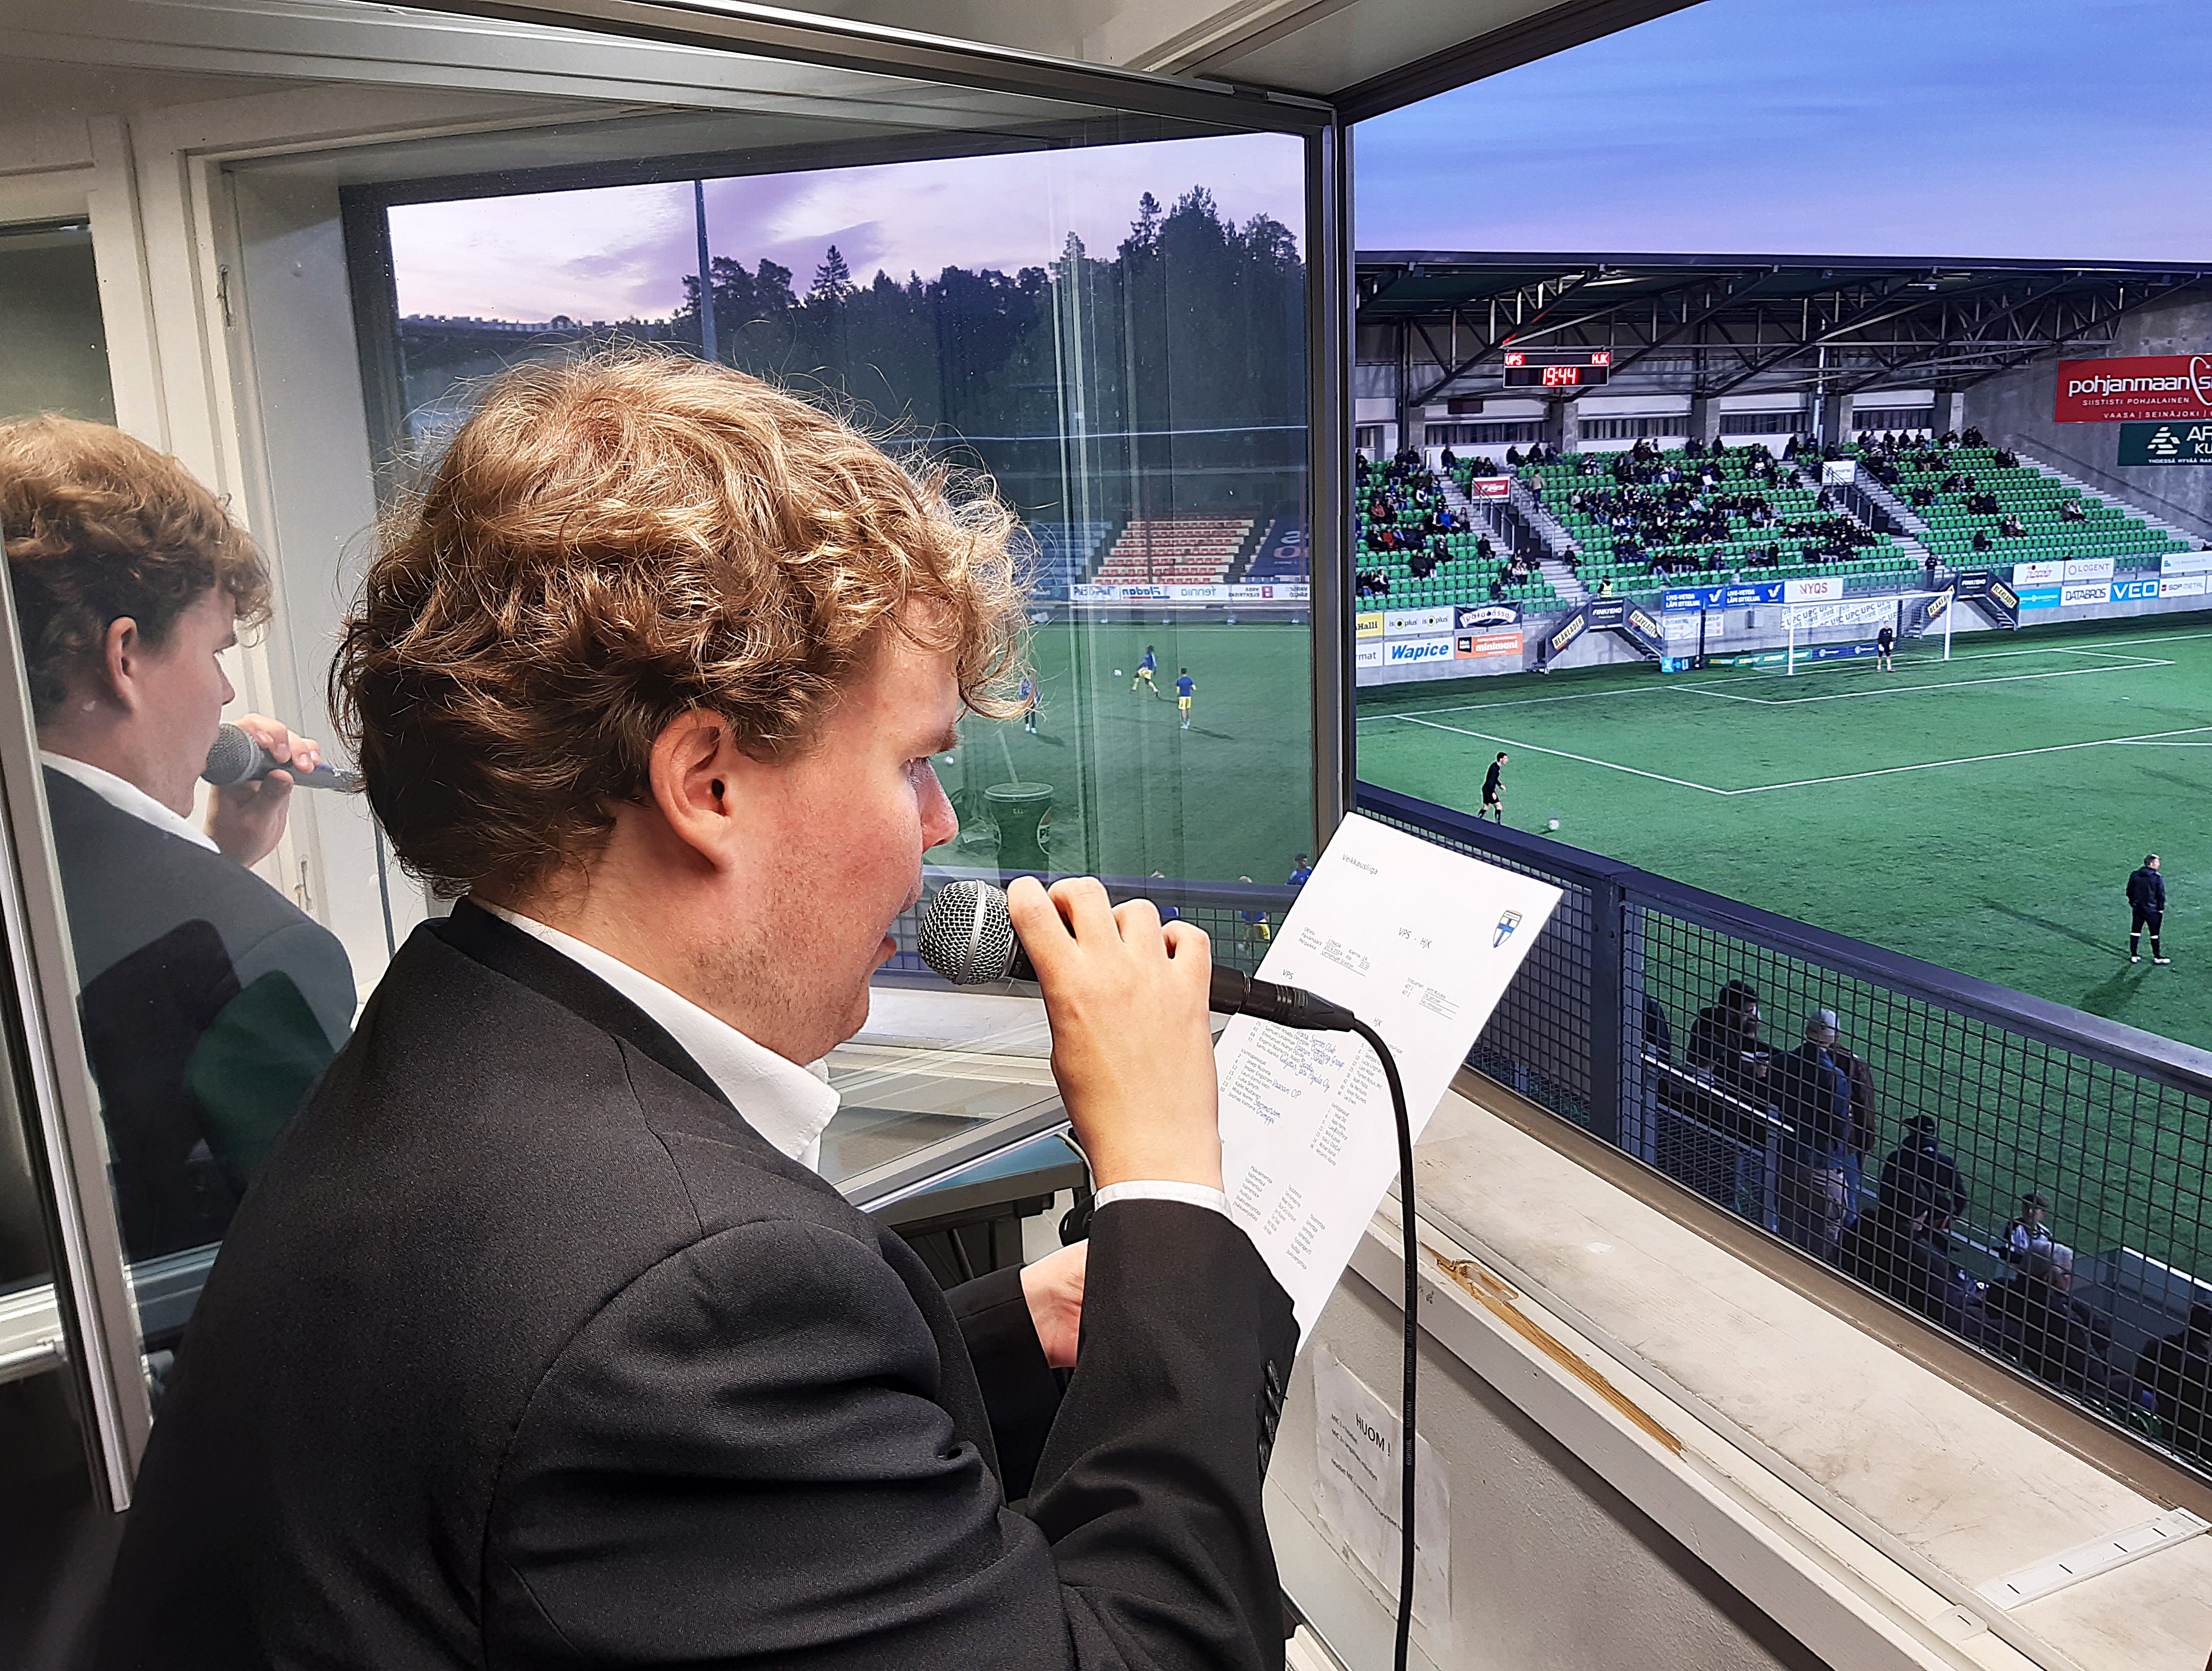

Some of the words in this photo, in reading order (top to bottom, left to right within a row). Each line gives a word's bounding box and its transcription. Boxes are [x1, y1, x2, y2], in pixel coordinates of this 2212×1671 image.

[1592, 353, 1608, 365] HJK
[1542, 367, 1576, 386] 19:44
[2068, 375, 2190, 397] pohjanmaan
[2082, 398, 2123, 406] SIISTISTI
[2127, 397, 2190, 405] POHJALAINEN
[2065, 588, 2107, 601] DATABROS
[2112, 581, 2158, 599] VEO
[1860, 603, 1876, 614] UPC
[1845, 610, 1860, 620] UPC
[1355, 621, 1378, 631] Halli
[1391, 642, 1449, 661] Wapice
[1341, 854, 1379, 875] Veikkausliiga
[1399, 927, 1411, 939] VPS
[1420, 937, 1432, 948] HJK
[1282, 968, 1294, 980] VPS
[1373, 1017, 1383, 1027] HJK
[1291, 1089, 1301, 1099] OP
[1355, 1413, 1385, 1452] HUOM
